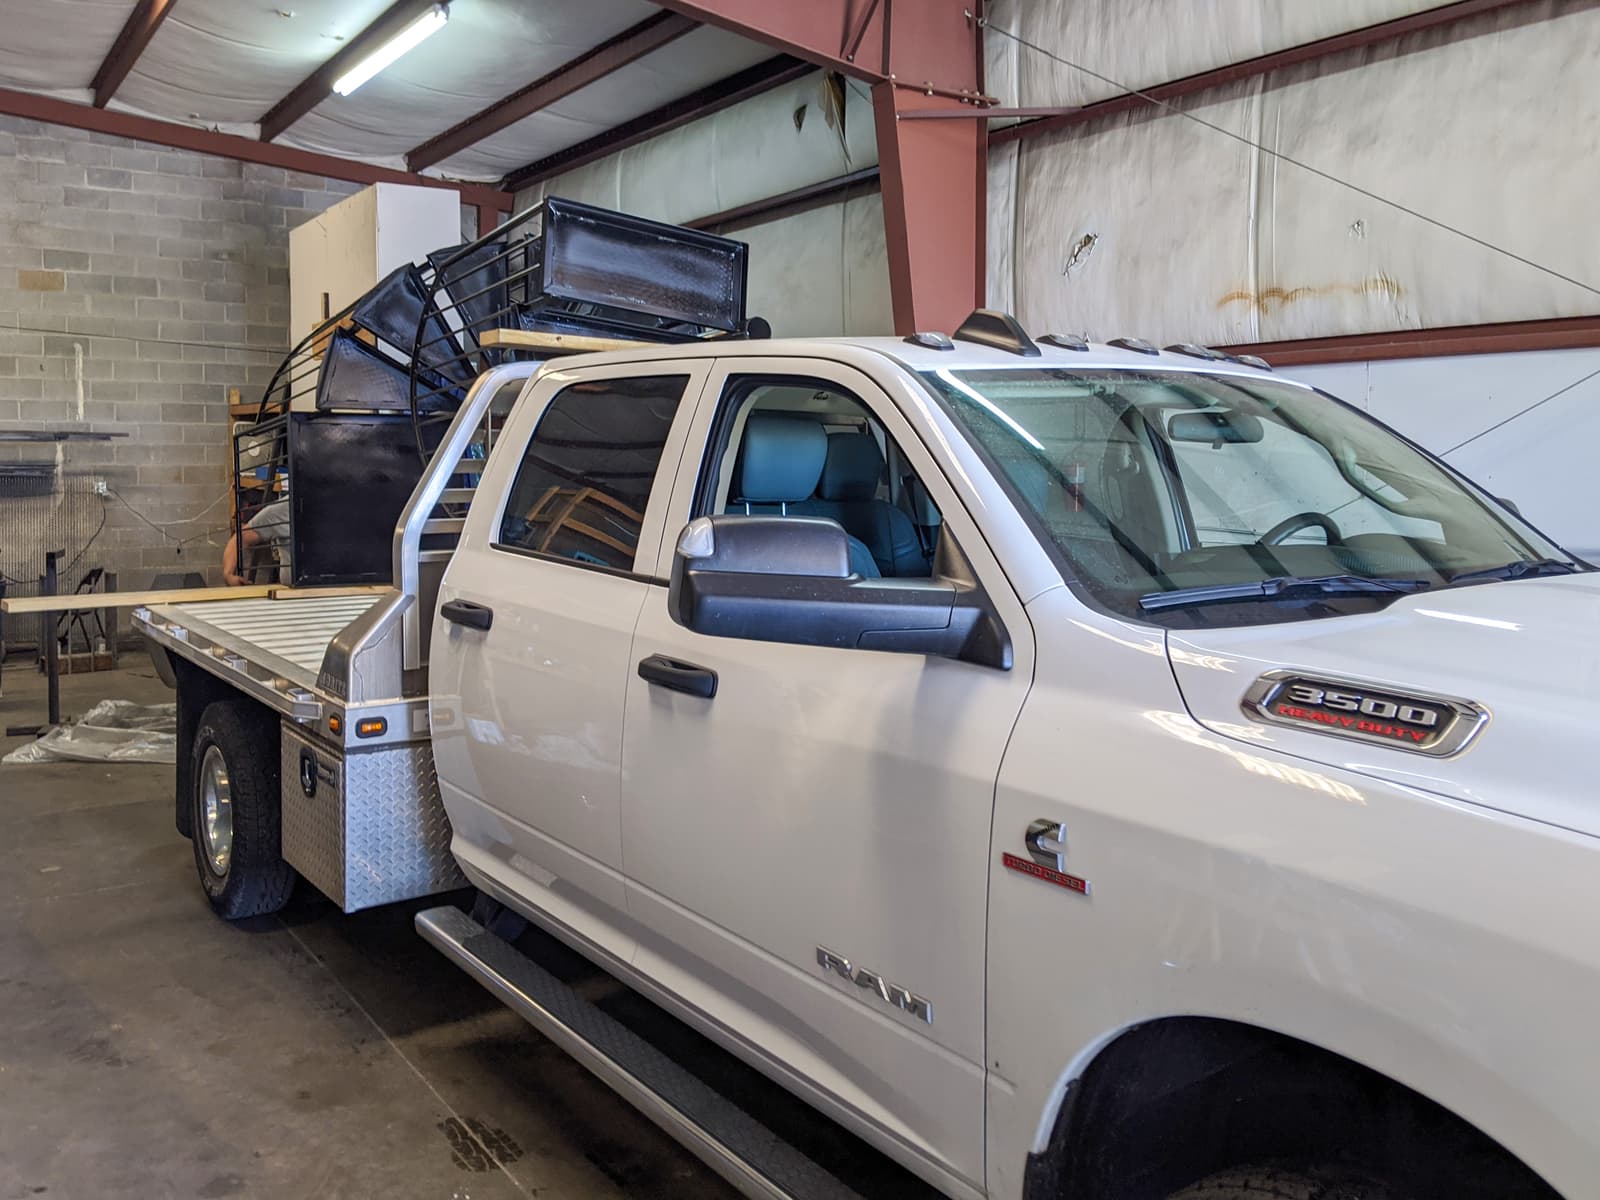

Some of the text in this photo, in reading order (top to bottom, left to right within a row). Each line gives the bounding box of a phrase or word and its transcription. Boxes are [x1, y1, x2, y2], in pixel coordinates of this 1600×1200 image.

[1276, 704, 1426, 742] HEAVY DUTY
[1287, 685, 1438, 726] 3500
[816, 944, 934, 1024] RAM
